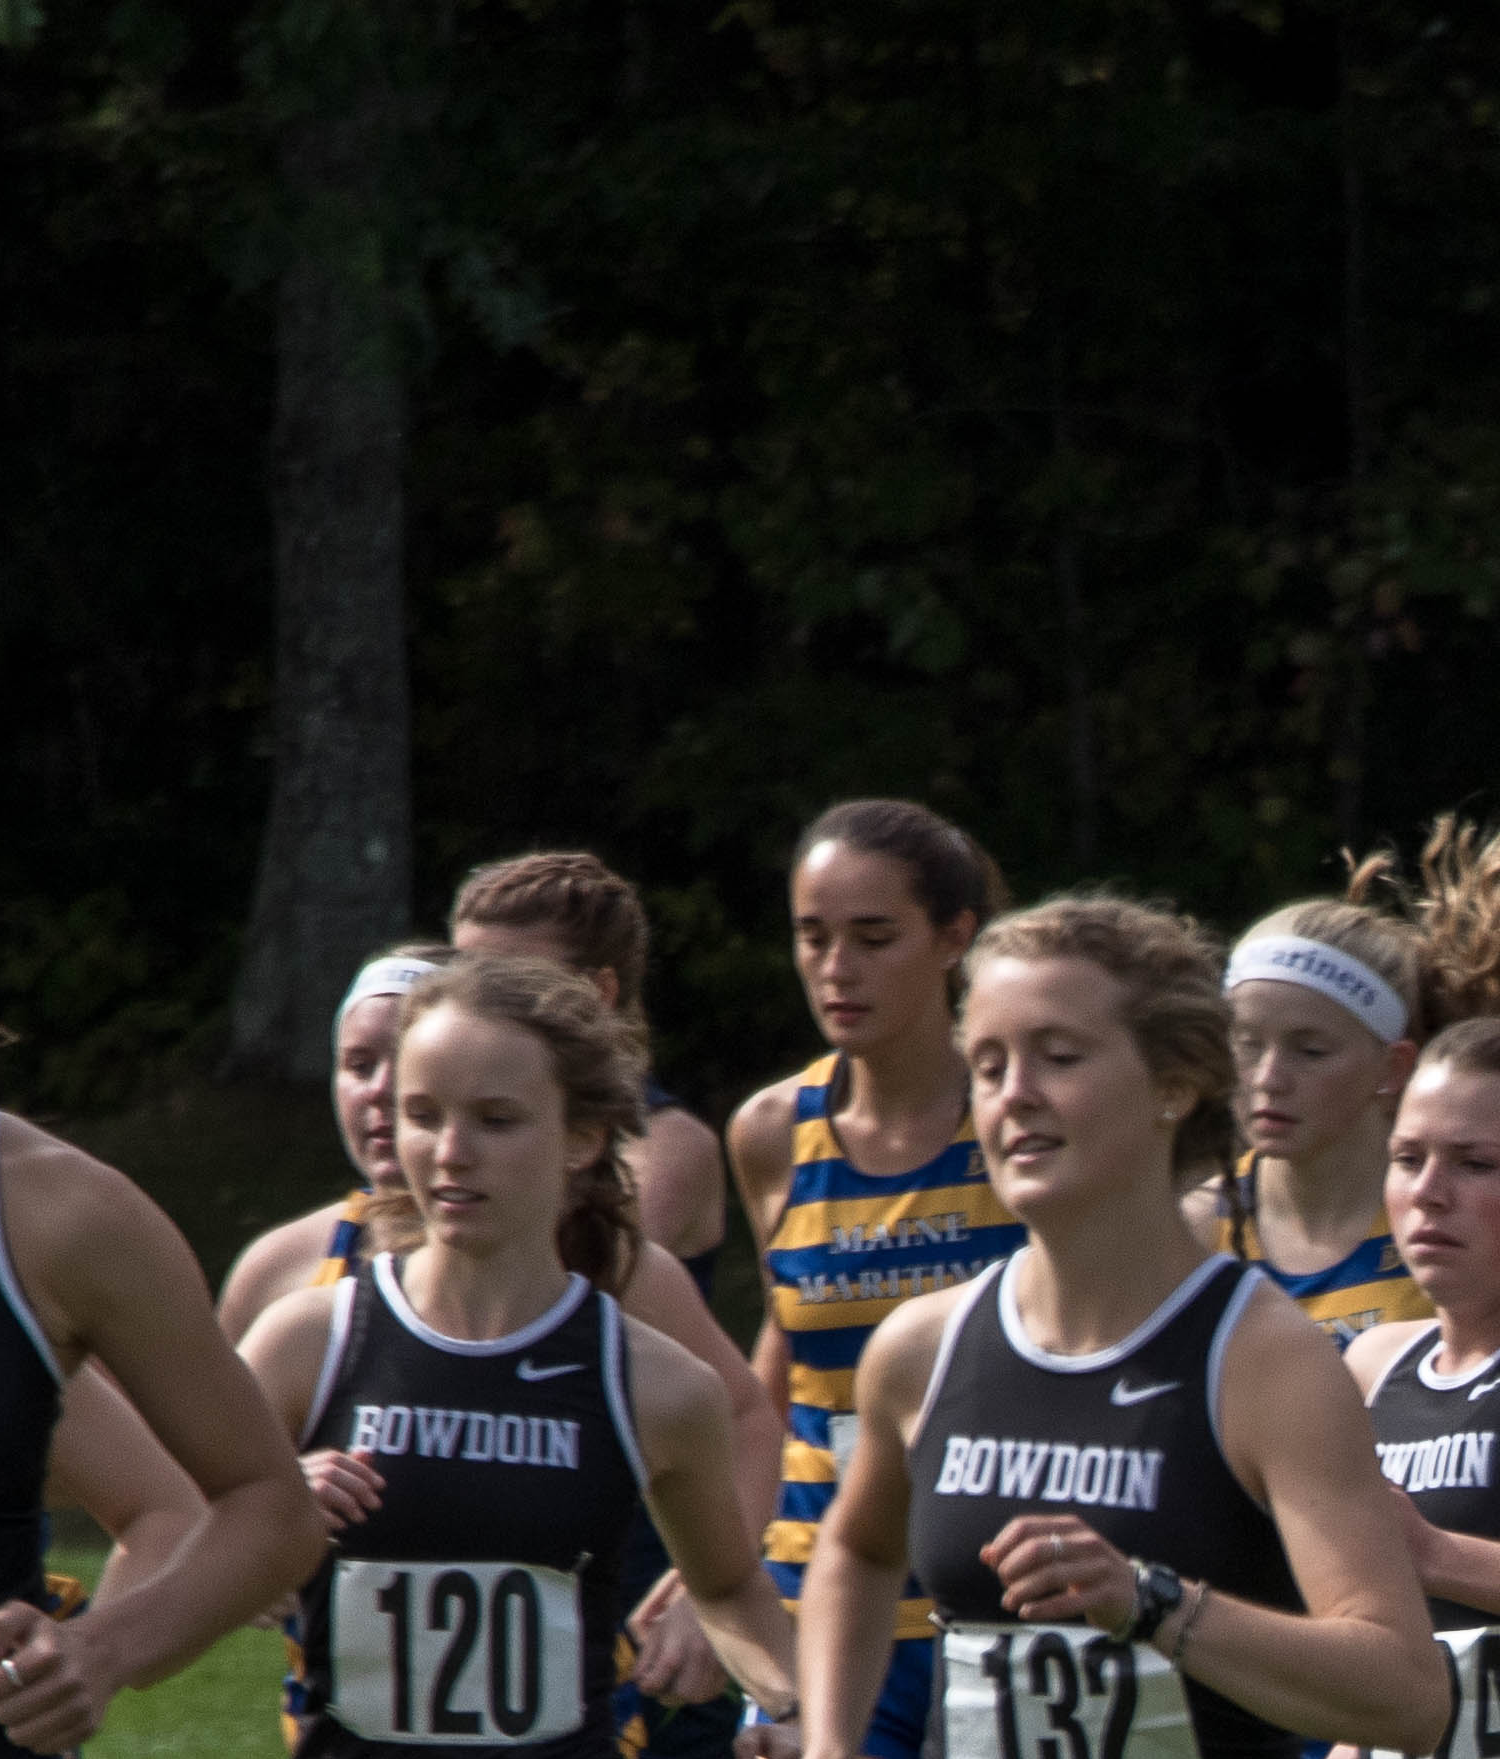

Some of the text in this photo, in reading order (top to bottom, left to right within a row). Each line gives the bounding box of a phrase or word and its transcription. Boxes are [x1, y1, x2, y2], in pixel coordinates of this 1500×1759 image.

[829, 1211, 971, 1255] MAINE
[351, 1404, 580, 1470] BOWDOIN
[934, 1437, 1164, 1511] BOWDOIN
[376, 1567, 546, 1739] 120
